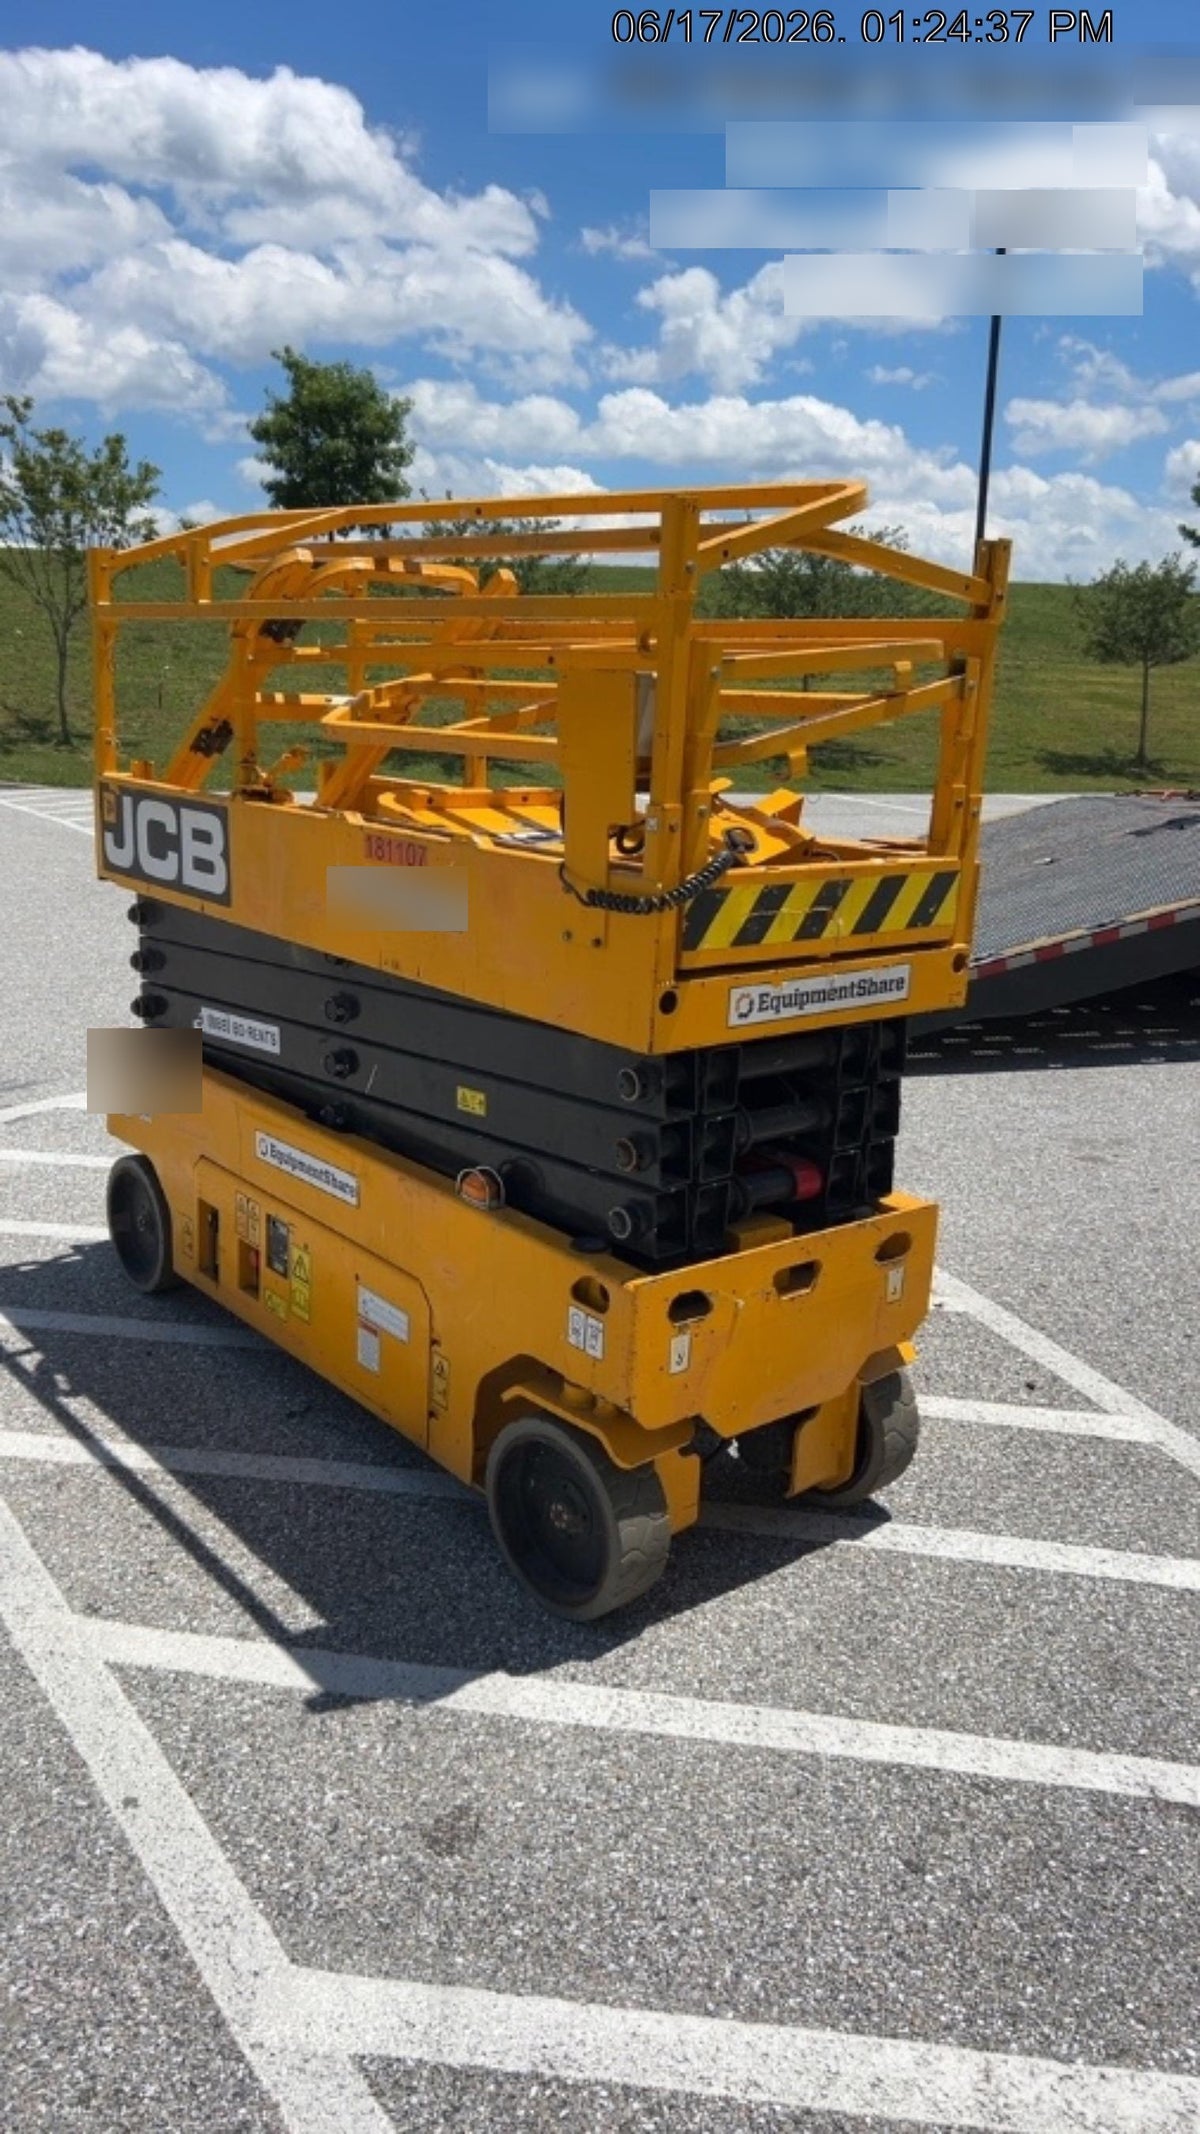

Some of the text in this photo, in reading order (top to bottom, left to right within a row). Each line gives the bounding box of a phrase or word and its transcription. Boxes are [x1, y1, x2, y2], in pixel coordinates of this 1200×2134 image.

[103, 795, 228, 895] JCB
[364, 833, 428, 867] 181107
[757, 975, 905, 1014] EquipmentShare
